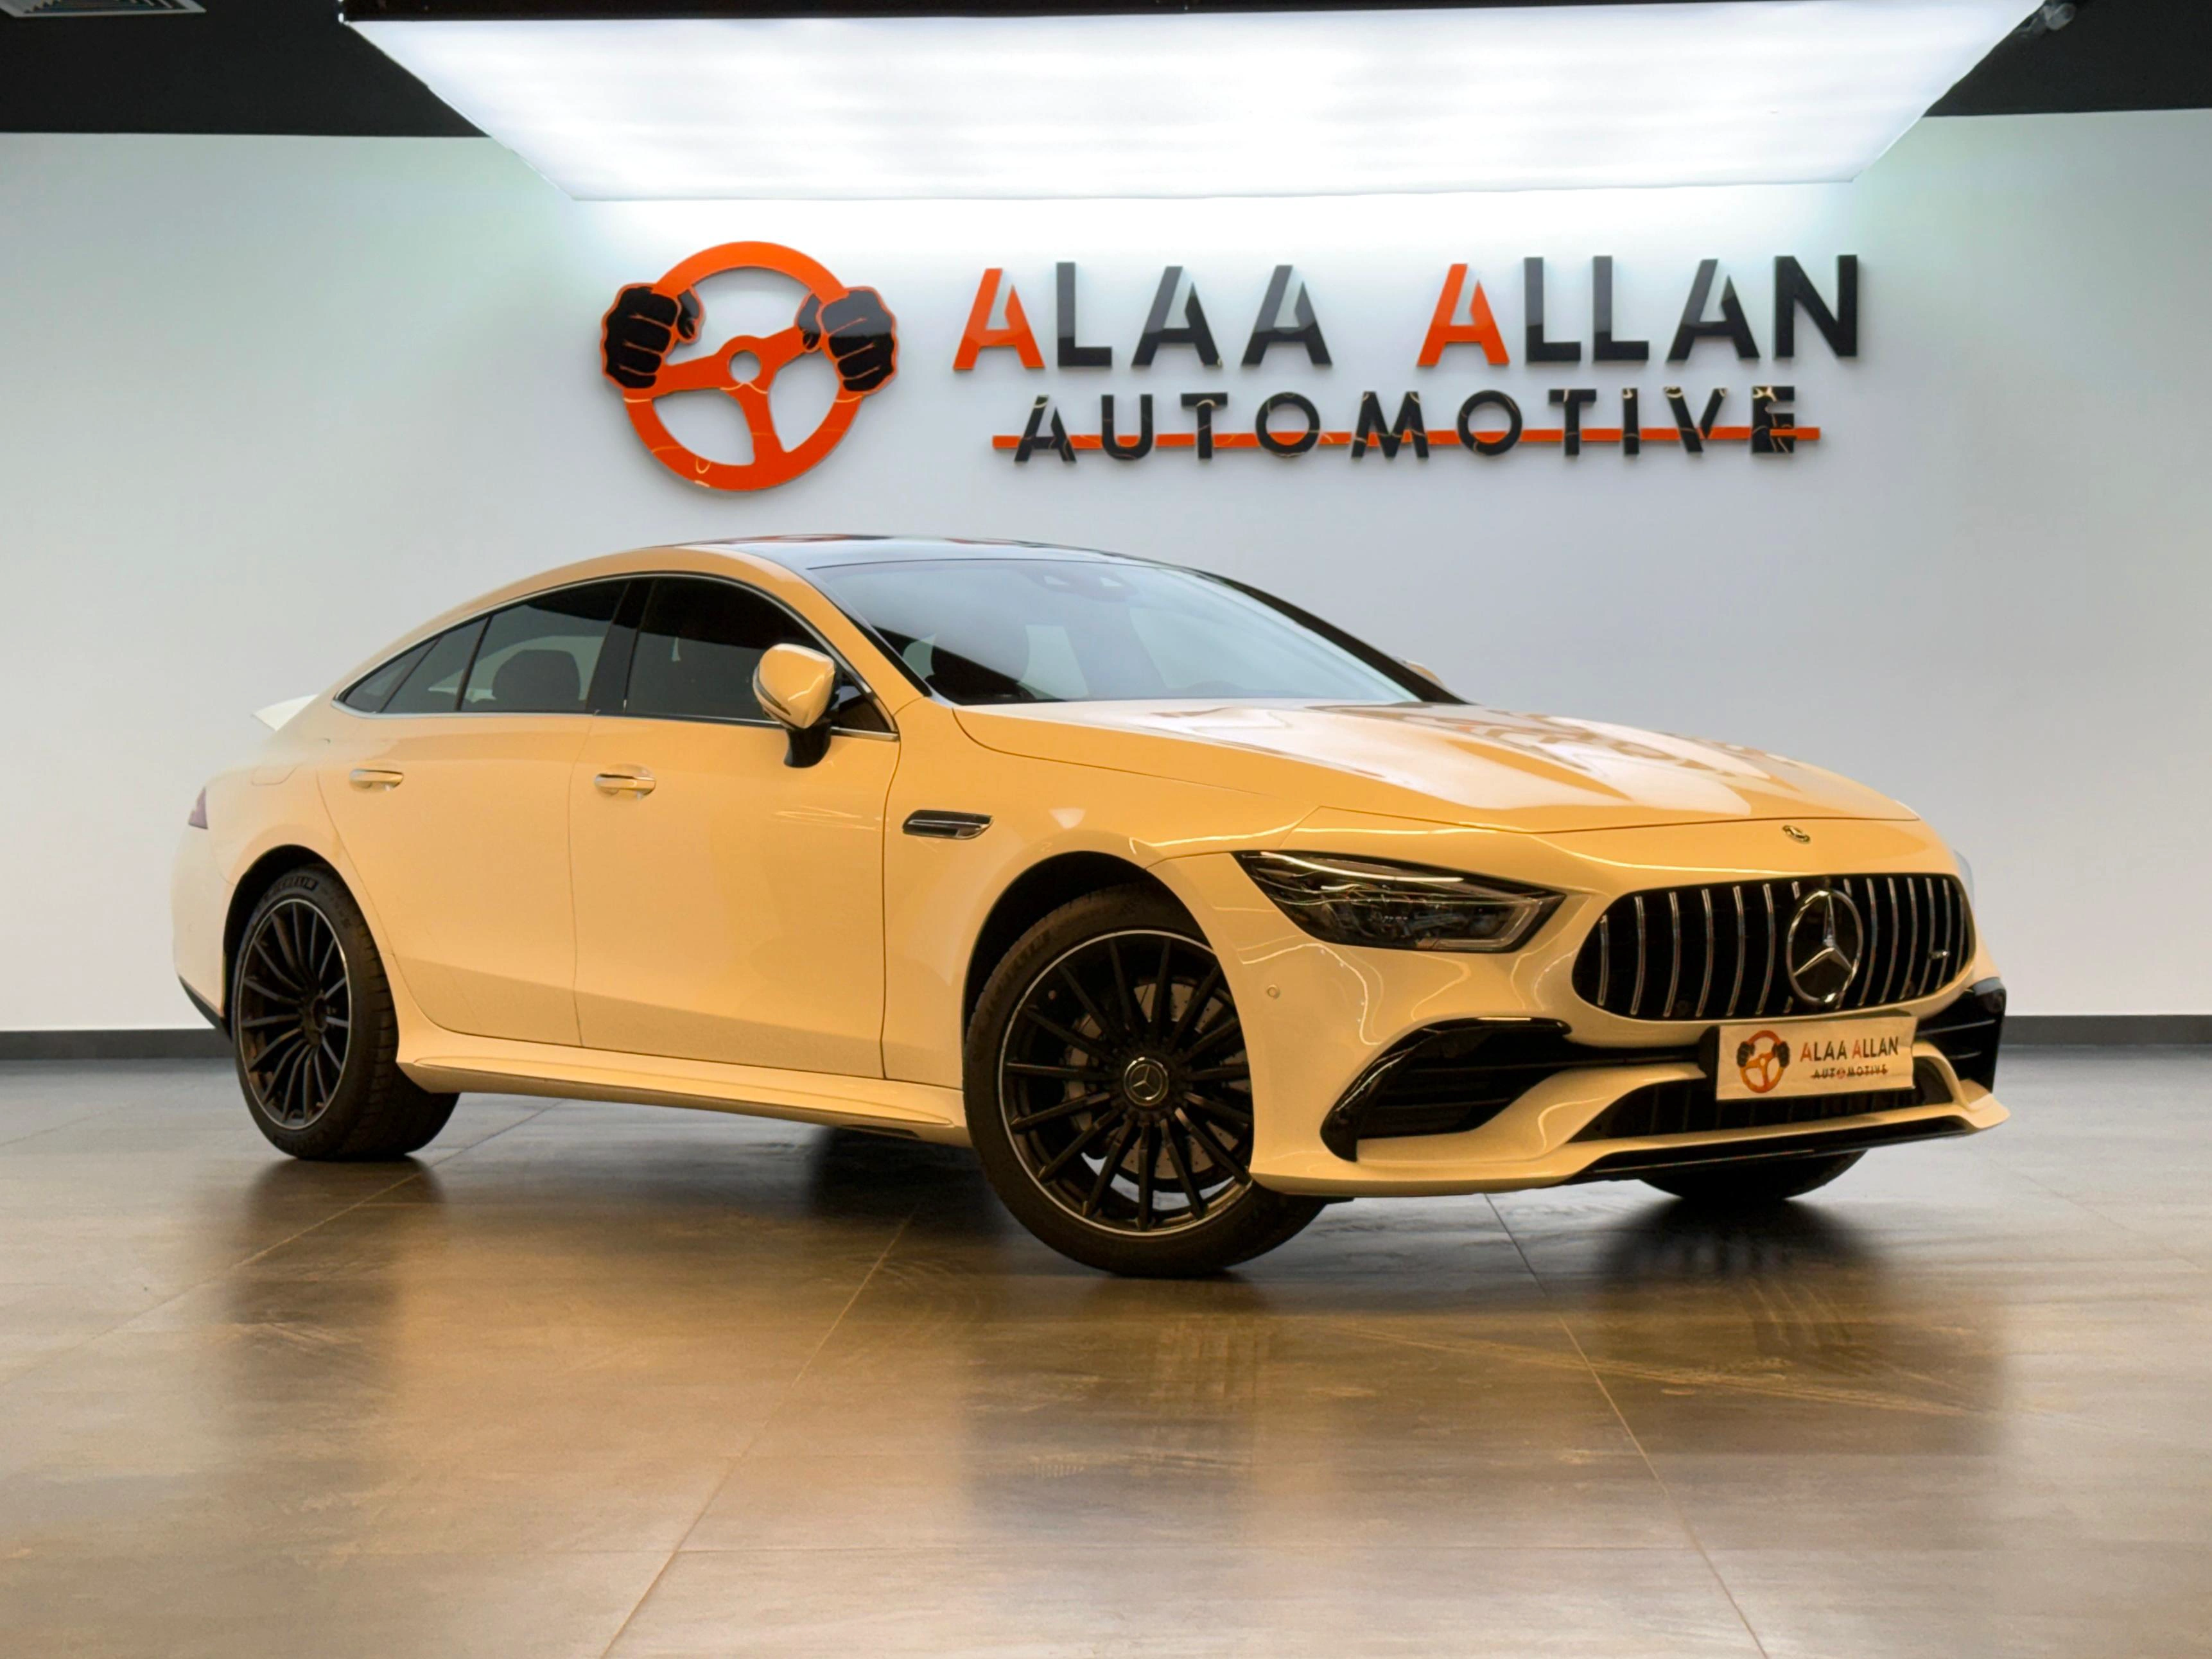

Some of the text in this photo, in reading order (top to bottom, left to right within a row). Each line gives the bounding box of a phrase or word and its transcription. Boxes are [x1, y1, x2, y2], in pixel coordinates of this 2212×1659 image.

[953, 254, 1858, 370] ALAA ALLAN
[1014, 386, 1795, 463] AUTOMOTIVE
[1800, 1036, 1898, 1062] ALAA ALLAN
[1813, 1064, 1886, 1079] AUTOMOTIVE
